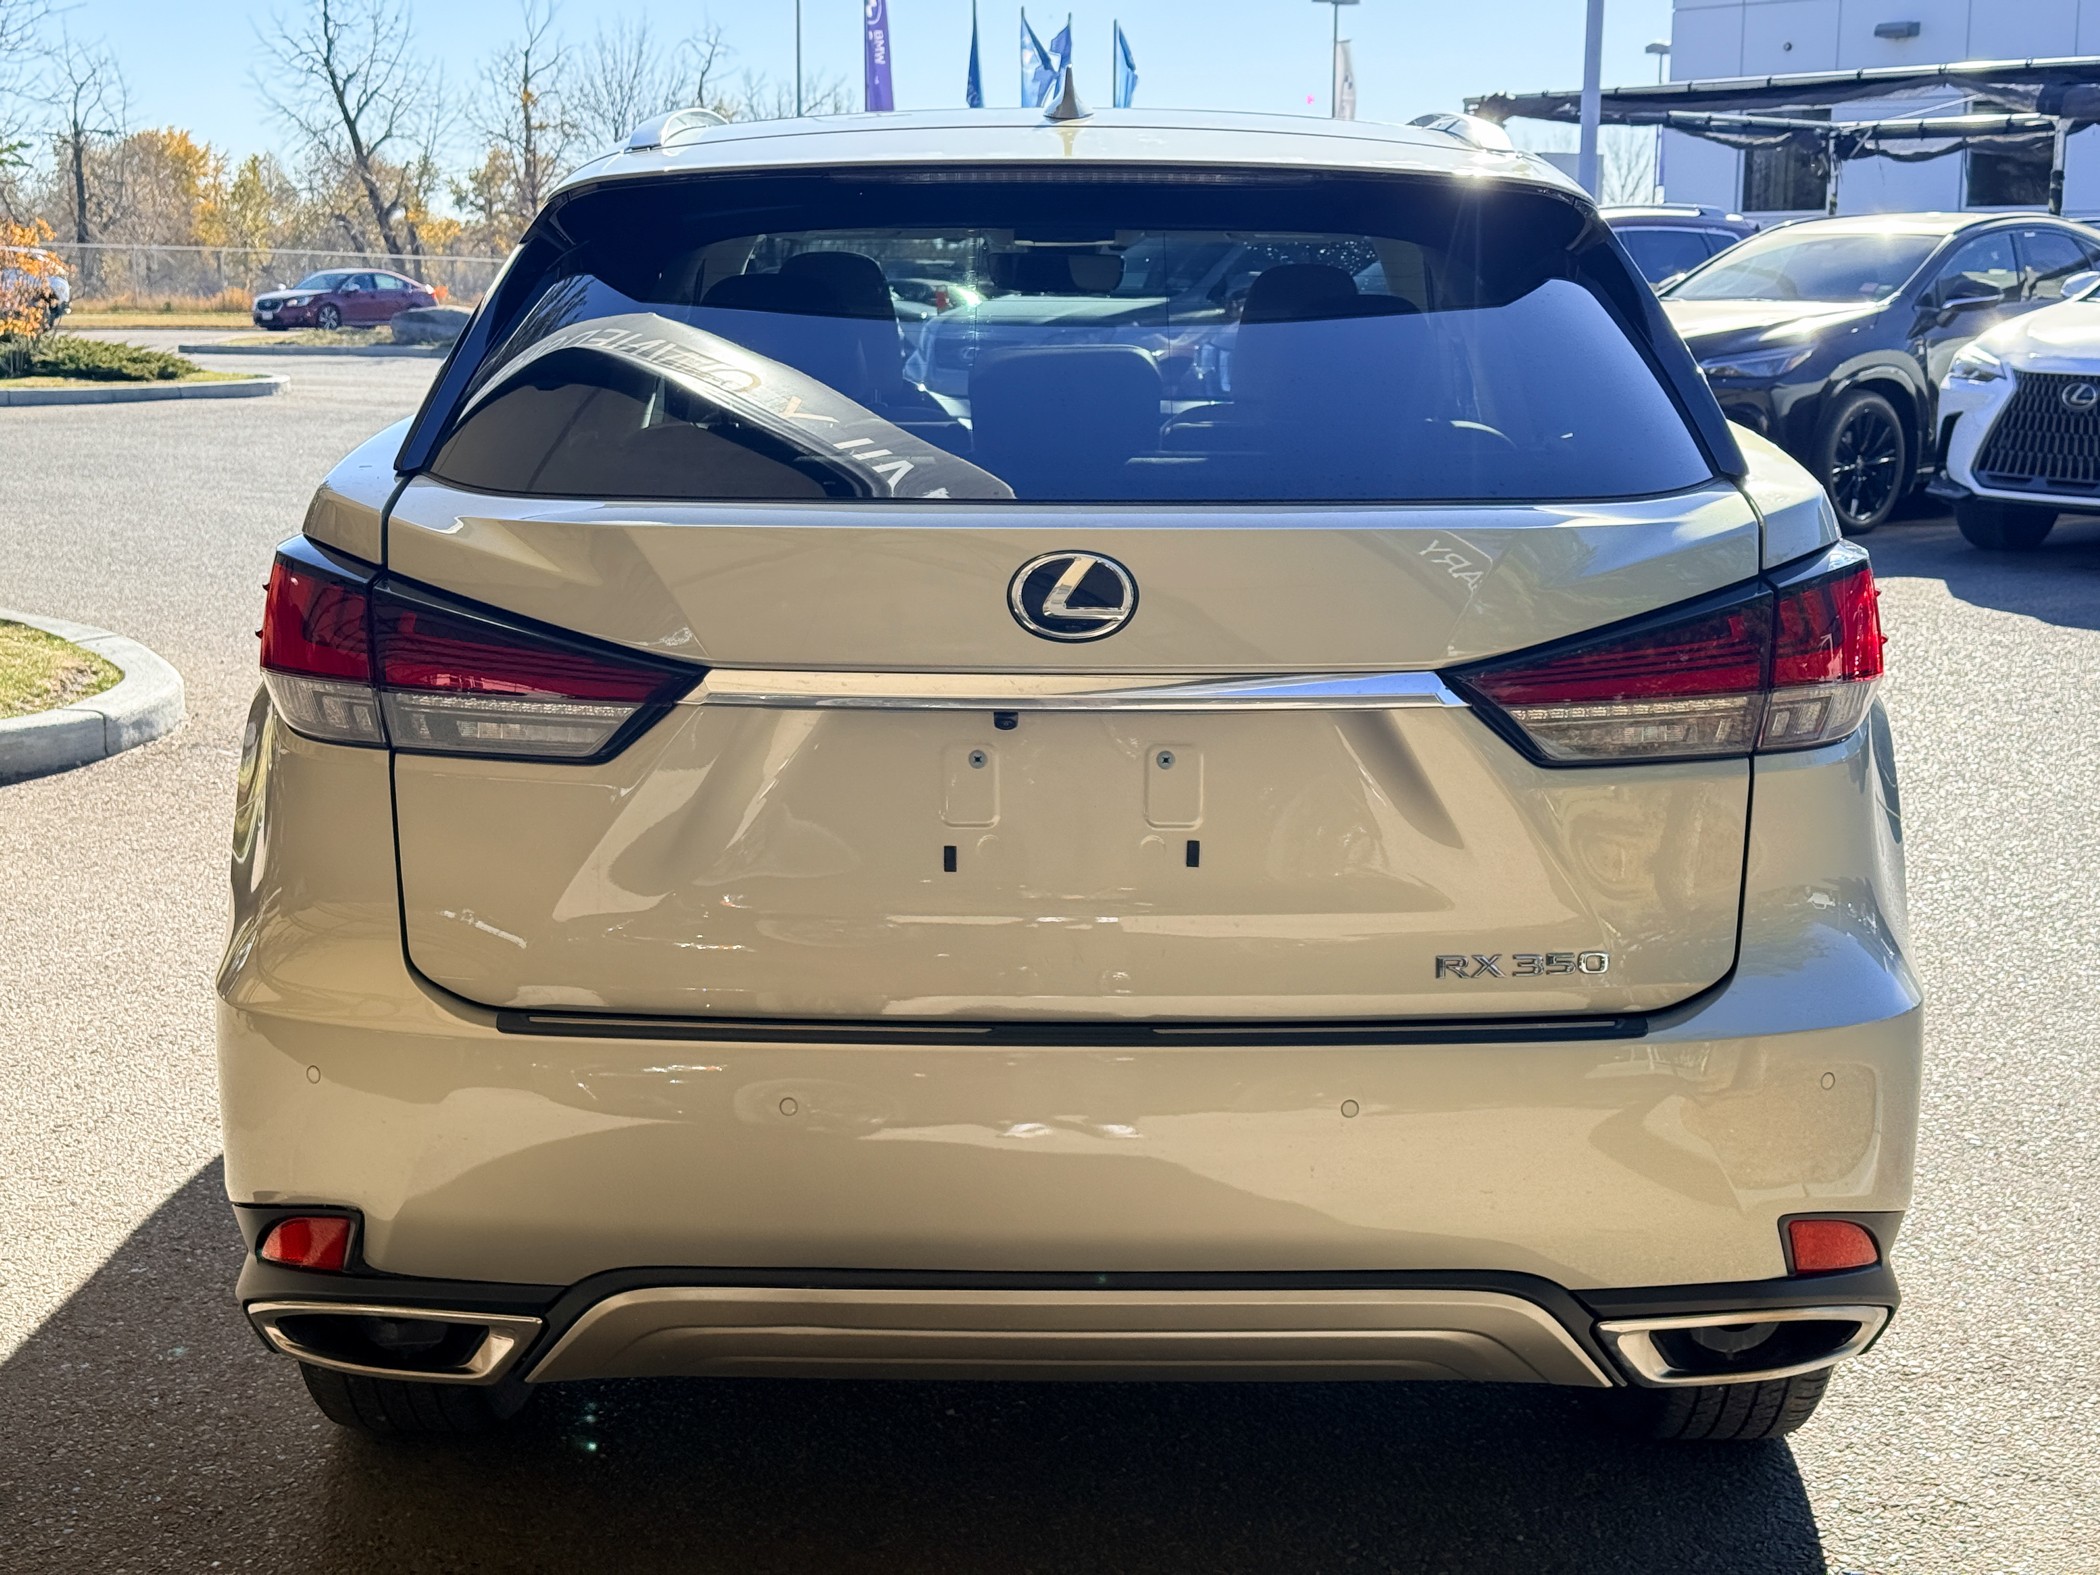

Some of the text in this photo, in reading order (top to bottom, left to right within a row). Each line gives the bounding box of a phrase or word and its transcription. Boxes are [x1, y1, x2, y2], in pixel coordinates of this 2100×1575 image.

[873, 29, 886, 64] BMW
[1435, 950, 1610, 979] RX 350
